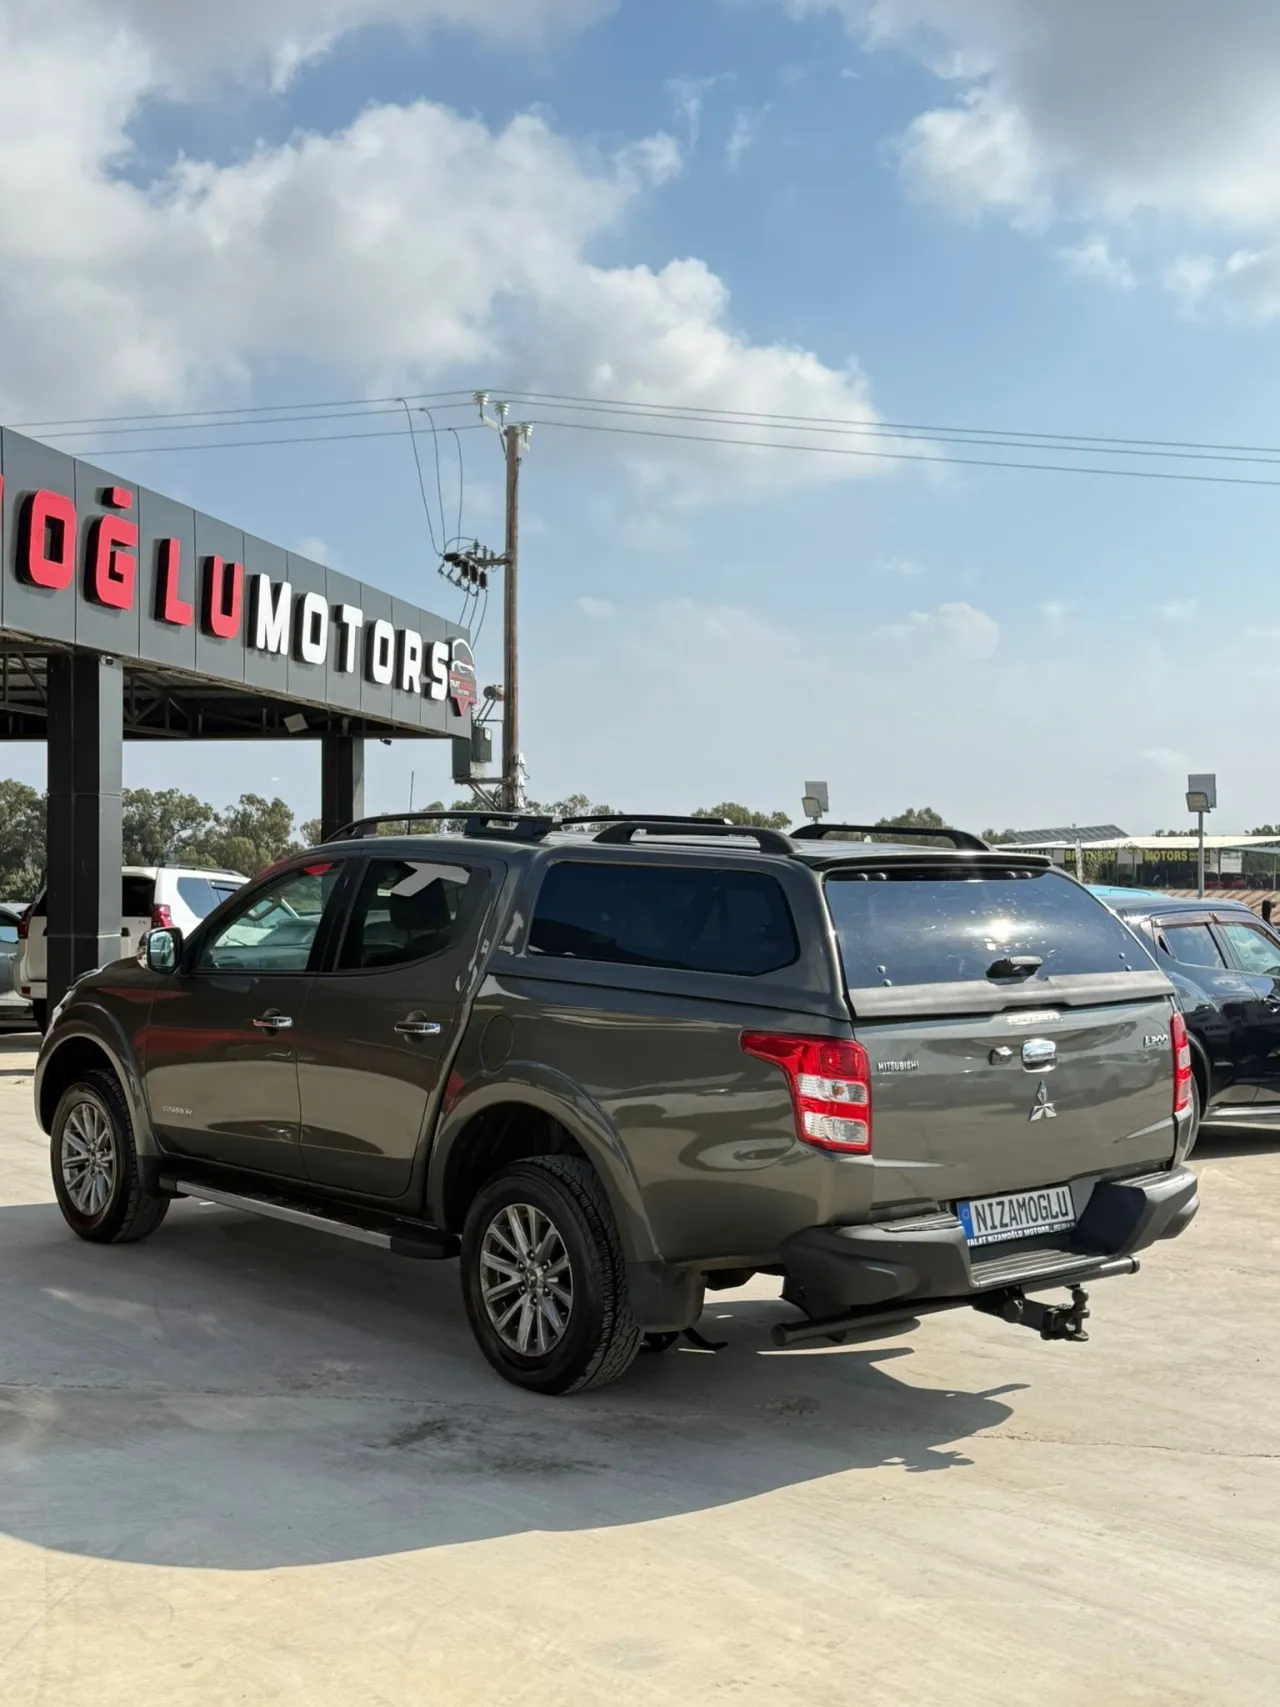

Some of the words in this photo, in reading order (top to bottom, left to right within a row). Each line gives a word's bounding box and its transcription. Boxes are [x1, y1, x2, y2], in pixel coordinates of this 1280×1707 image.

[0, 474, 243, 639] OĞLU
[251, 573, 448, 701] MOTORS
[1144, 850, 1188, 861] MOTORS
[877, 1060, 919, 1071] MITSUBISHI
[974, 1190, 1069, 1233] NIZAMOGLU
[967, 1236, 986, 1247] TALAT
[1023, 1226, 1050, 1236] MOTORS
